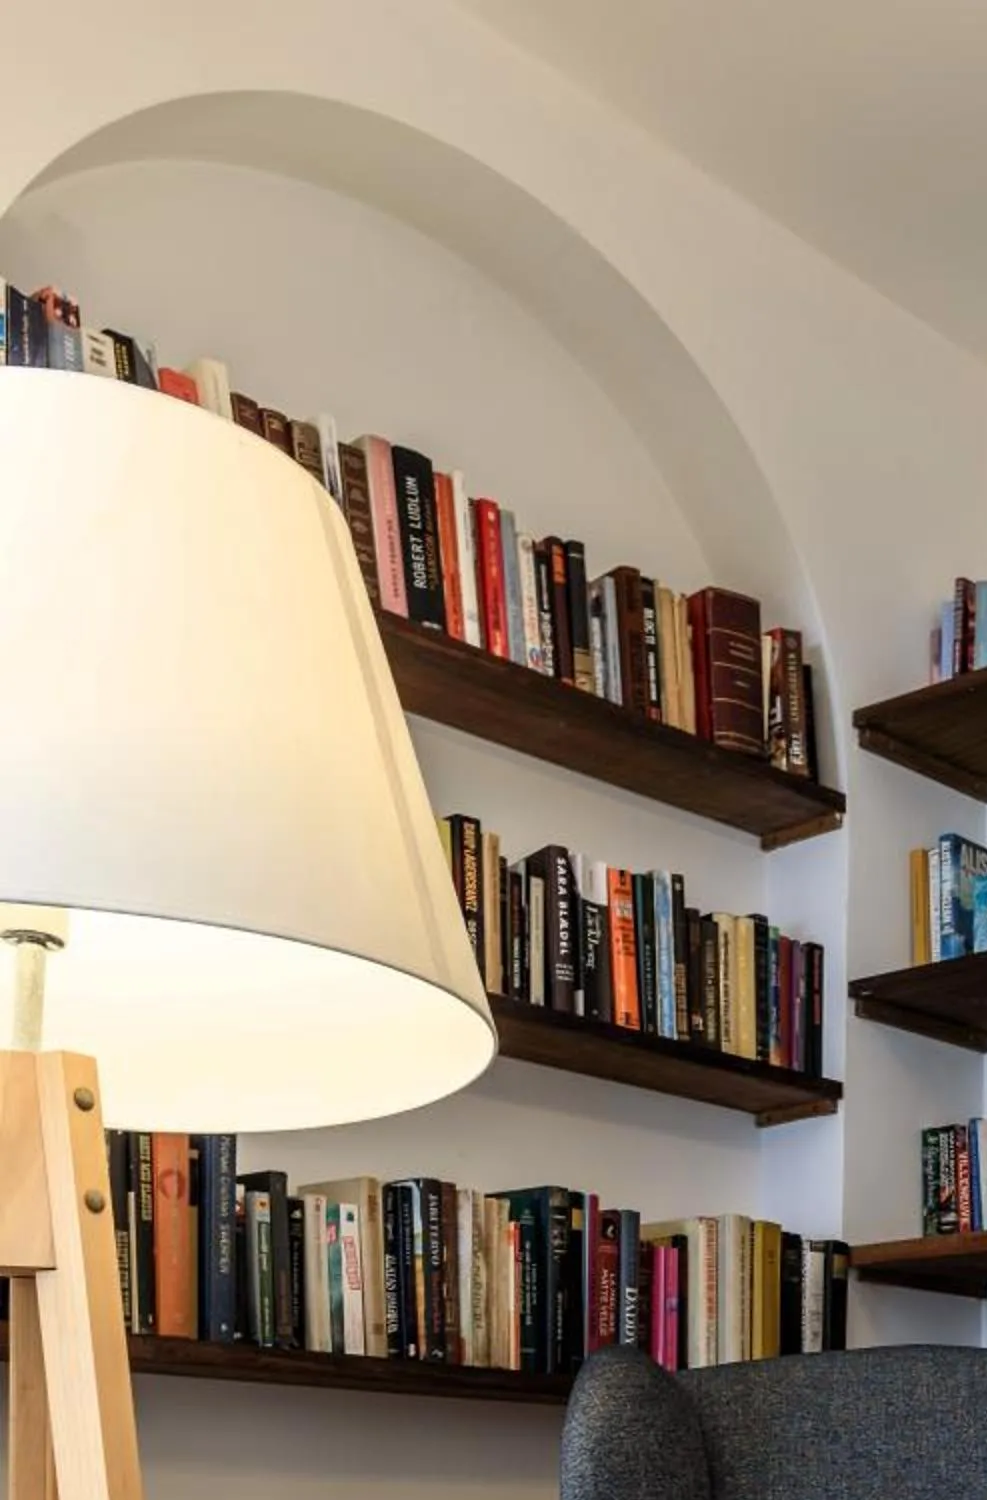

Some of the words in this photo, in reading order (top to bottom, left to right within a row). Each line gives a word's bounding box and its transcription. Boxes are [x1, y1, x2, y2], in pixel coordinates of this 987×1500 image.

[405, 475, 421, 529] LUDLUM
[410, 534, 428, 589] ROBERT
[557, 856, 569, 896] SARA
[558, 900, 570, 956] BLÆDEL
[624, 1286, 639, 1344] DADDY
